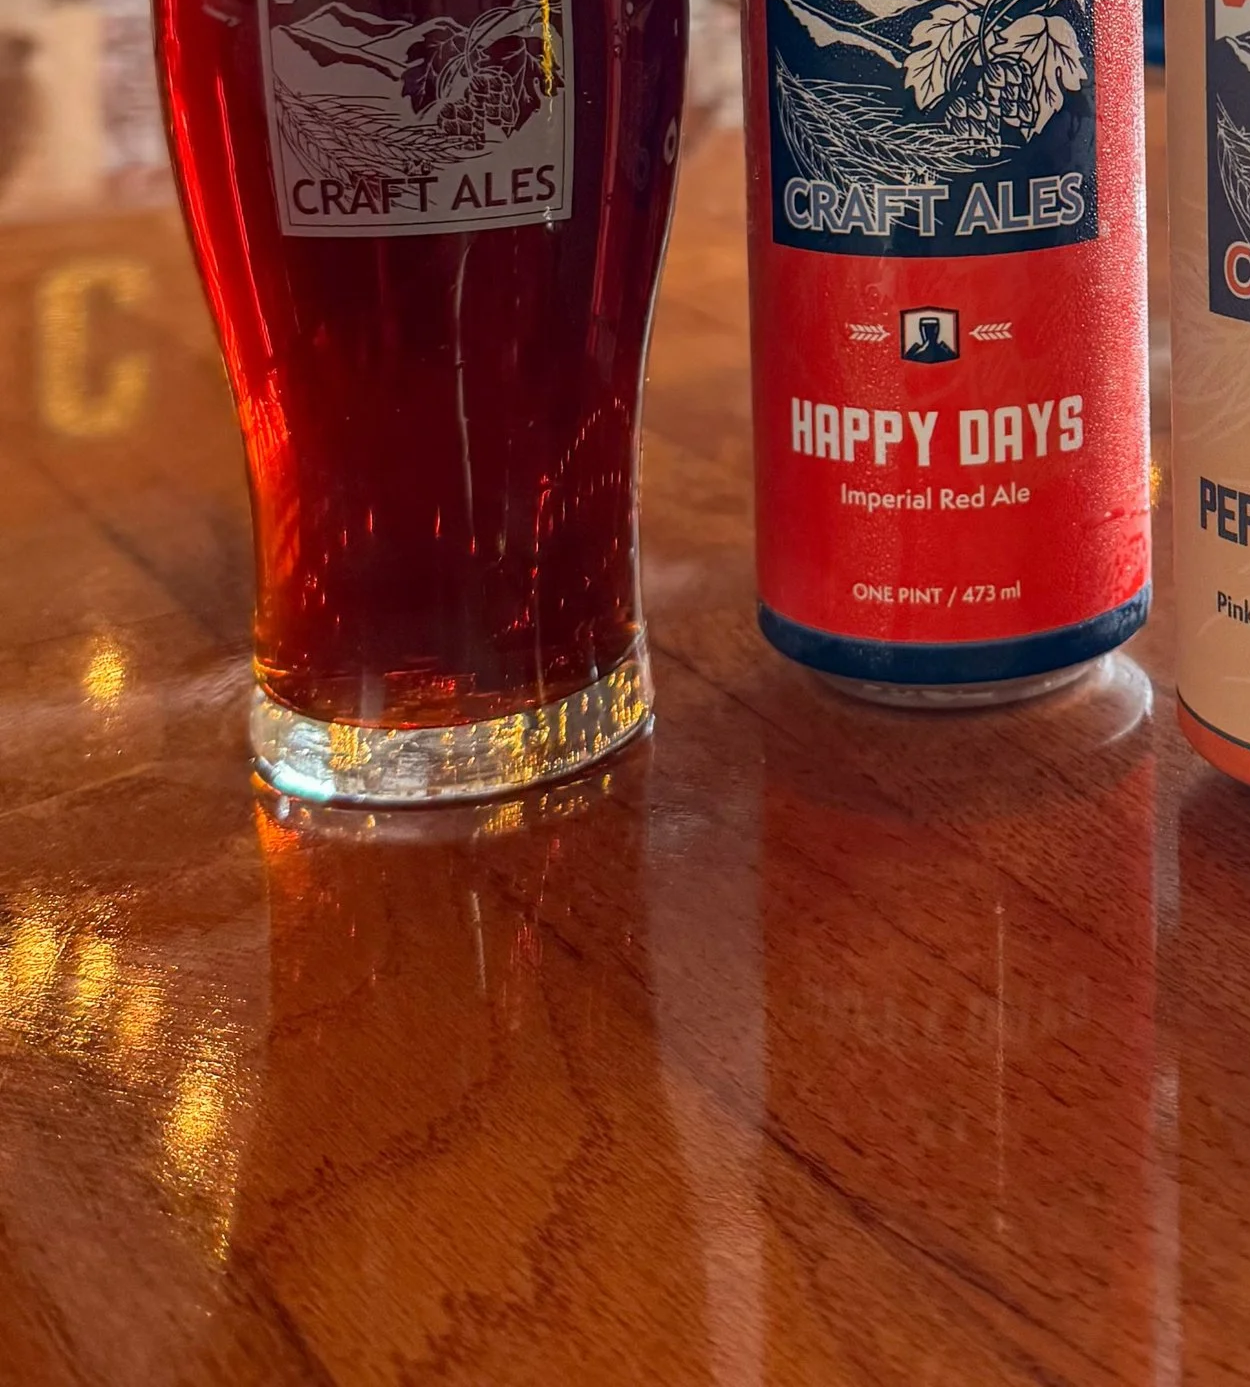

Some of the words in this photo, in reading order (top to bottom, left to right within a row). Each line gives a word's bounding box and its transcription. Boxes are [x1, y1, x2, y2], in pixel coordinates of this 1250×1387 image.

[292, 175, 438, 216] CRAFT
[452, 164, 557, 210] ALES
[783, 178, 948, 238] CRAFT
[956, 173, 1085, 236] ALES
[791, 397, 938, 467] HAPPY
[959, 395, 1084, 466] DAYS
[840, 483, 932, 512] Imperial
[940, 484, 985, 509] Red
[991, 481, 1031, 505] Ale
[852, 582, 894, 603] ONE
[899, 586, 942, 605] PINT
[962, 584, 996, 603] 473
[1001, 580, 1021, 600] ml
